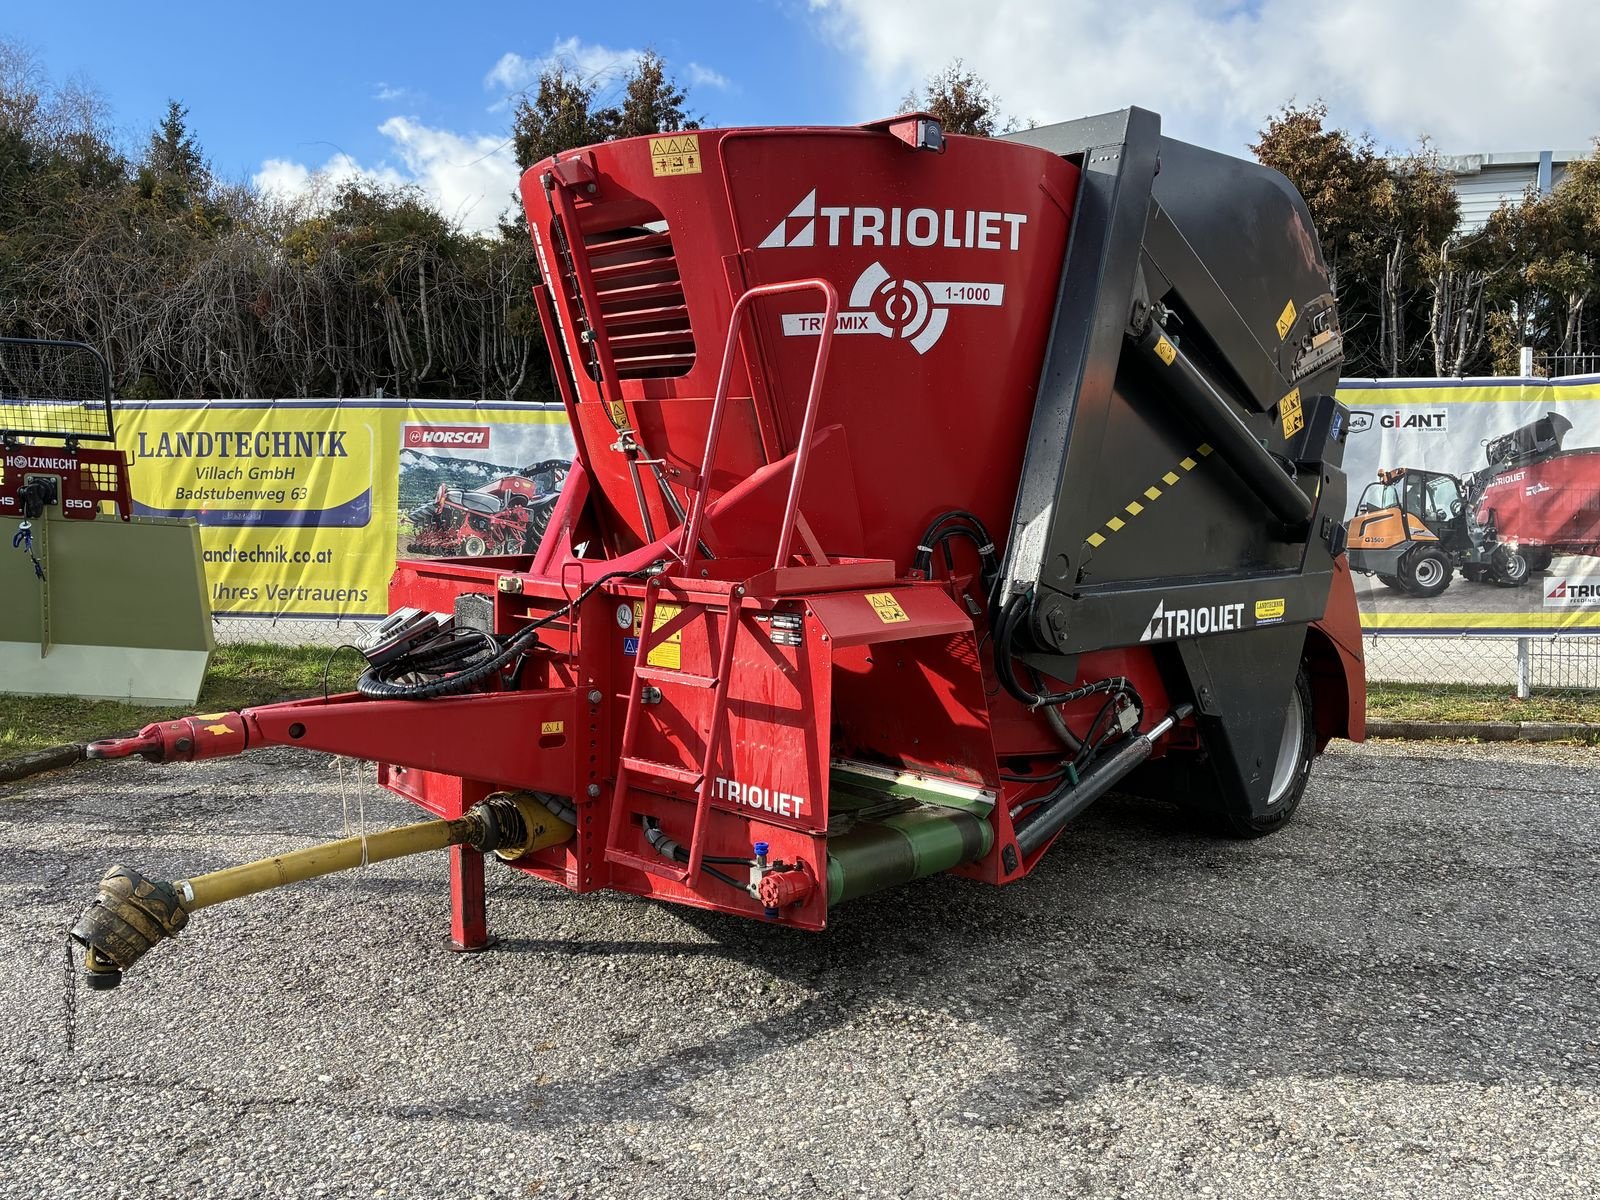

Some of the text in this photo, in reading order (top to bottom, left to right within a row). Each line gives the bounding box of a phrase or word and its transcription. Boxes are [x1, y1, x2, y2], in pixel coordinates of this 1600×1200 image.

[820, 207, 1028, 251] TRIOLIET
[945, 286, 991, 301] 1-1000
[137, 431, 348, 458] LANDTECHNIK
[422, 432, 484, 444] HORSCH
[6, 455, 78, 470] HOLZKNECHT
[196, 466, 295, 480] Villach GmbH
[175, 487, 308, 503] Badstubenweg 63
[65, 499, 92, 509] 850
[203, 544, 332, 563] andtechnik.co.at
[213, 582, 369, 602] Ihres Vertrauens
[1164, 603, 1245, 638] TRIOLIET
[716, 777, 804, 819] TRIOLIET
